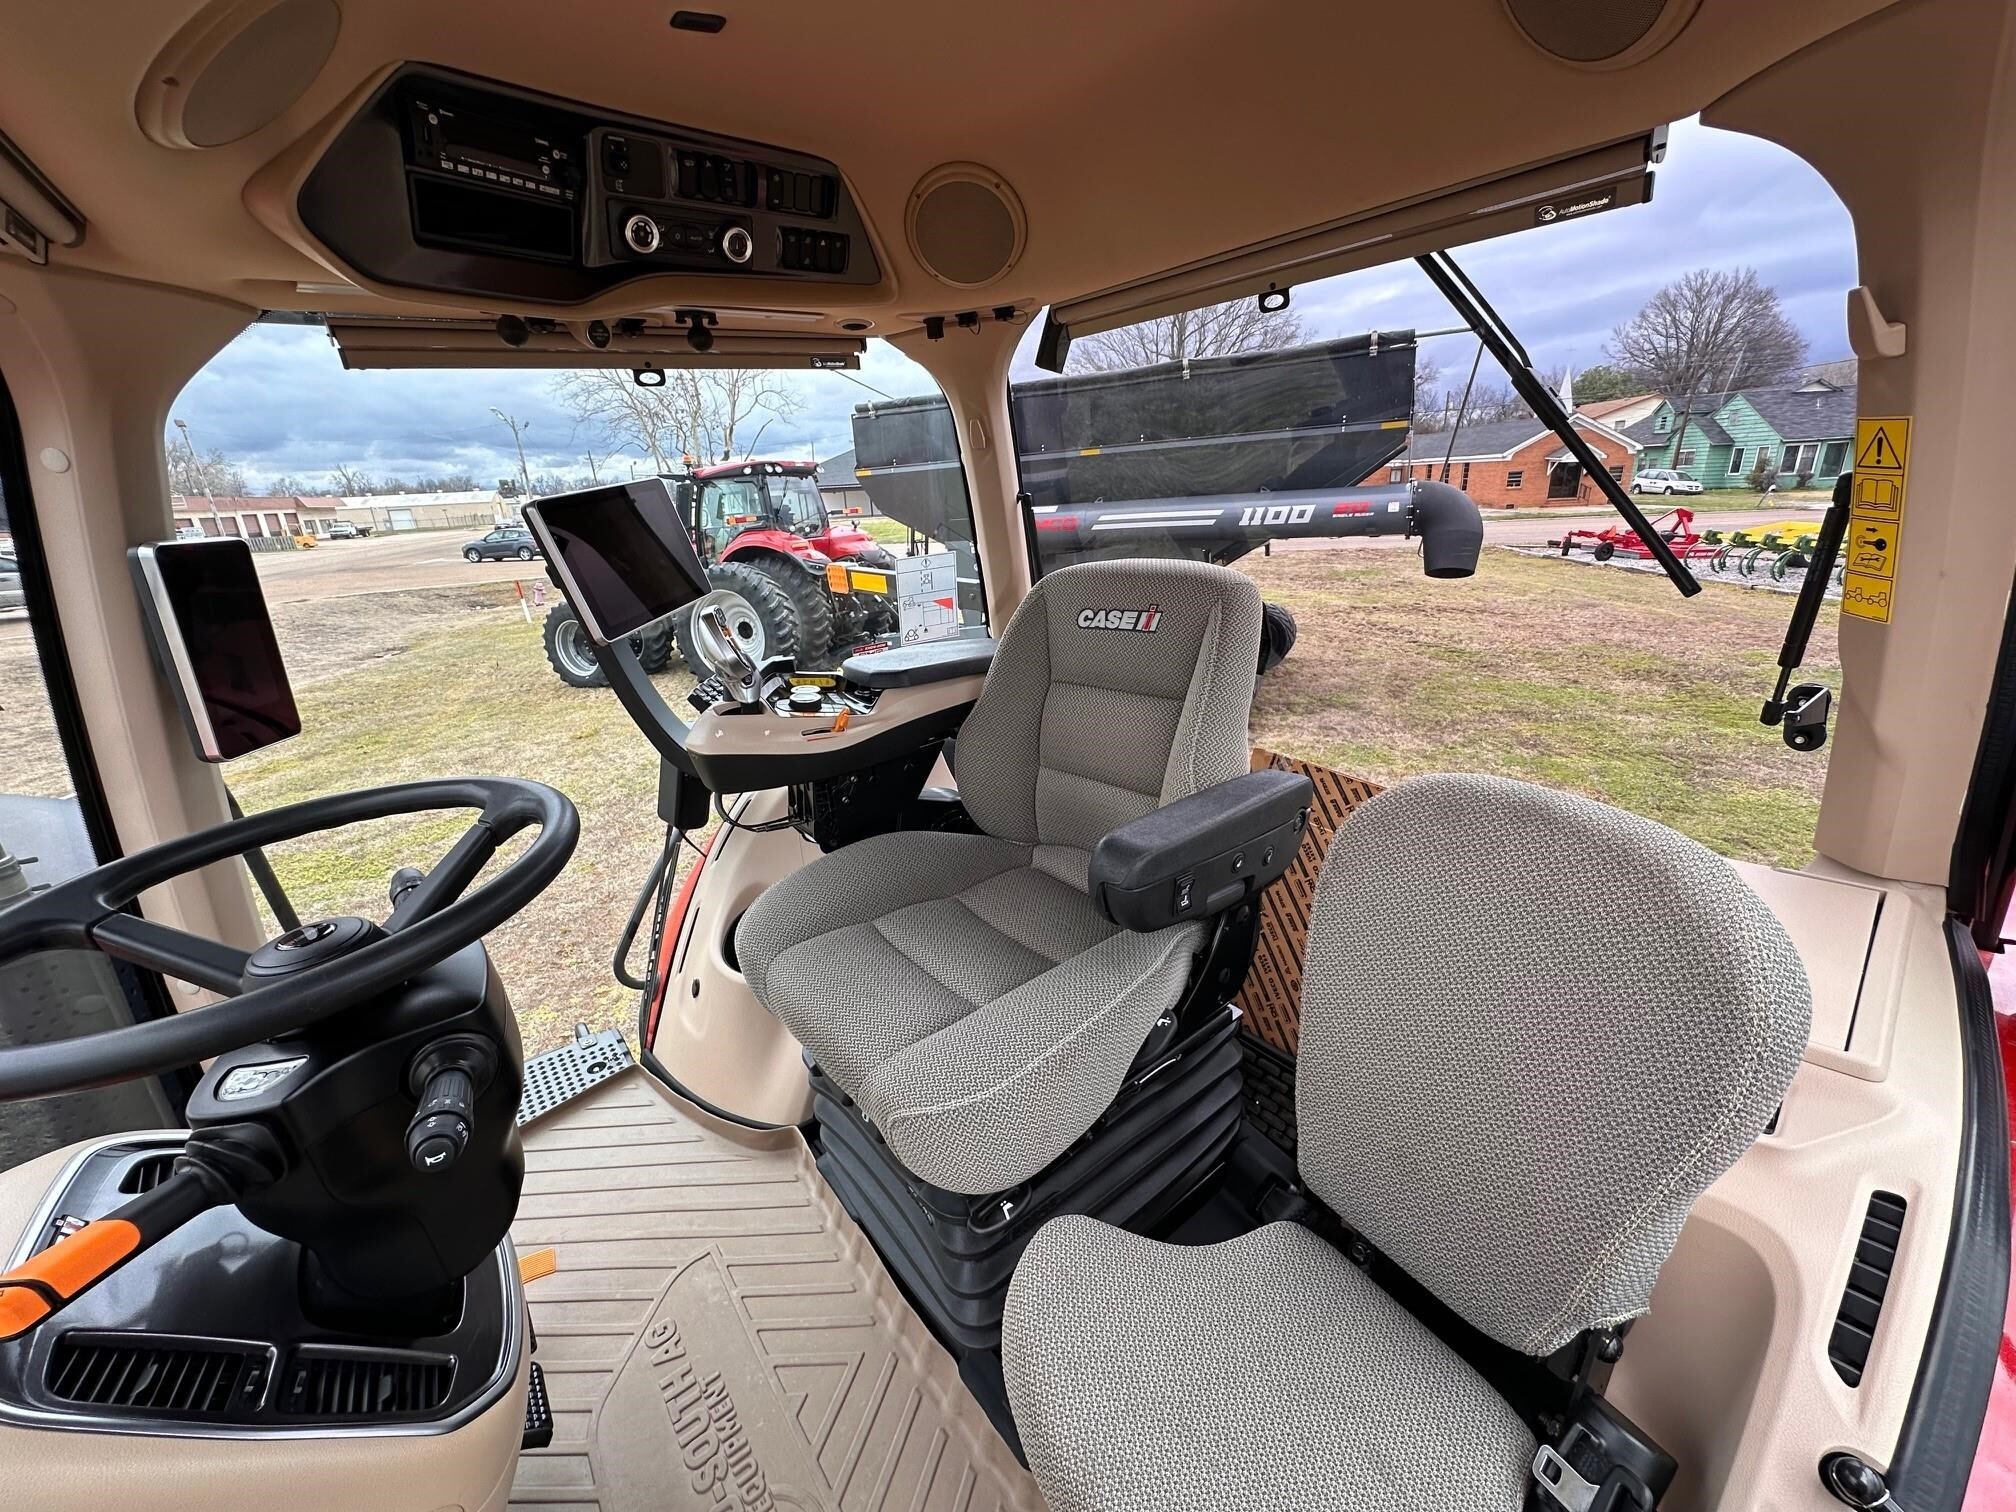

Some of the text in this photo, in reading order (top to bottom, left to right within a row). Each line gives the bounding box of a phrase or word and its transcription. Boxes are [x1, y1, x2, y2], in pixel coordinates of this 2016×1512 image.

[1238, 504, 1316, 526] 1100
[1077, 608, 1139, 630] CASE
[1313, 816, 1324, 835] IVECO
[1301, 843, 1312, 862] IVECO
[1265, 921, 1277, 941] IVECO
[1257, 954, 1268, 974] IVECO
[1268, 977, 1280, 999] IVECO
[644, 1317, 686, 1367] AG
[699, 1371, 777, 1512] EQUIPMENT
